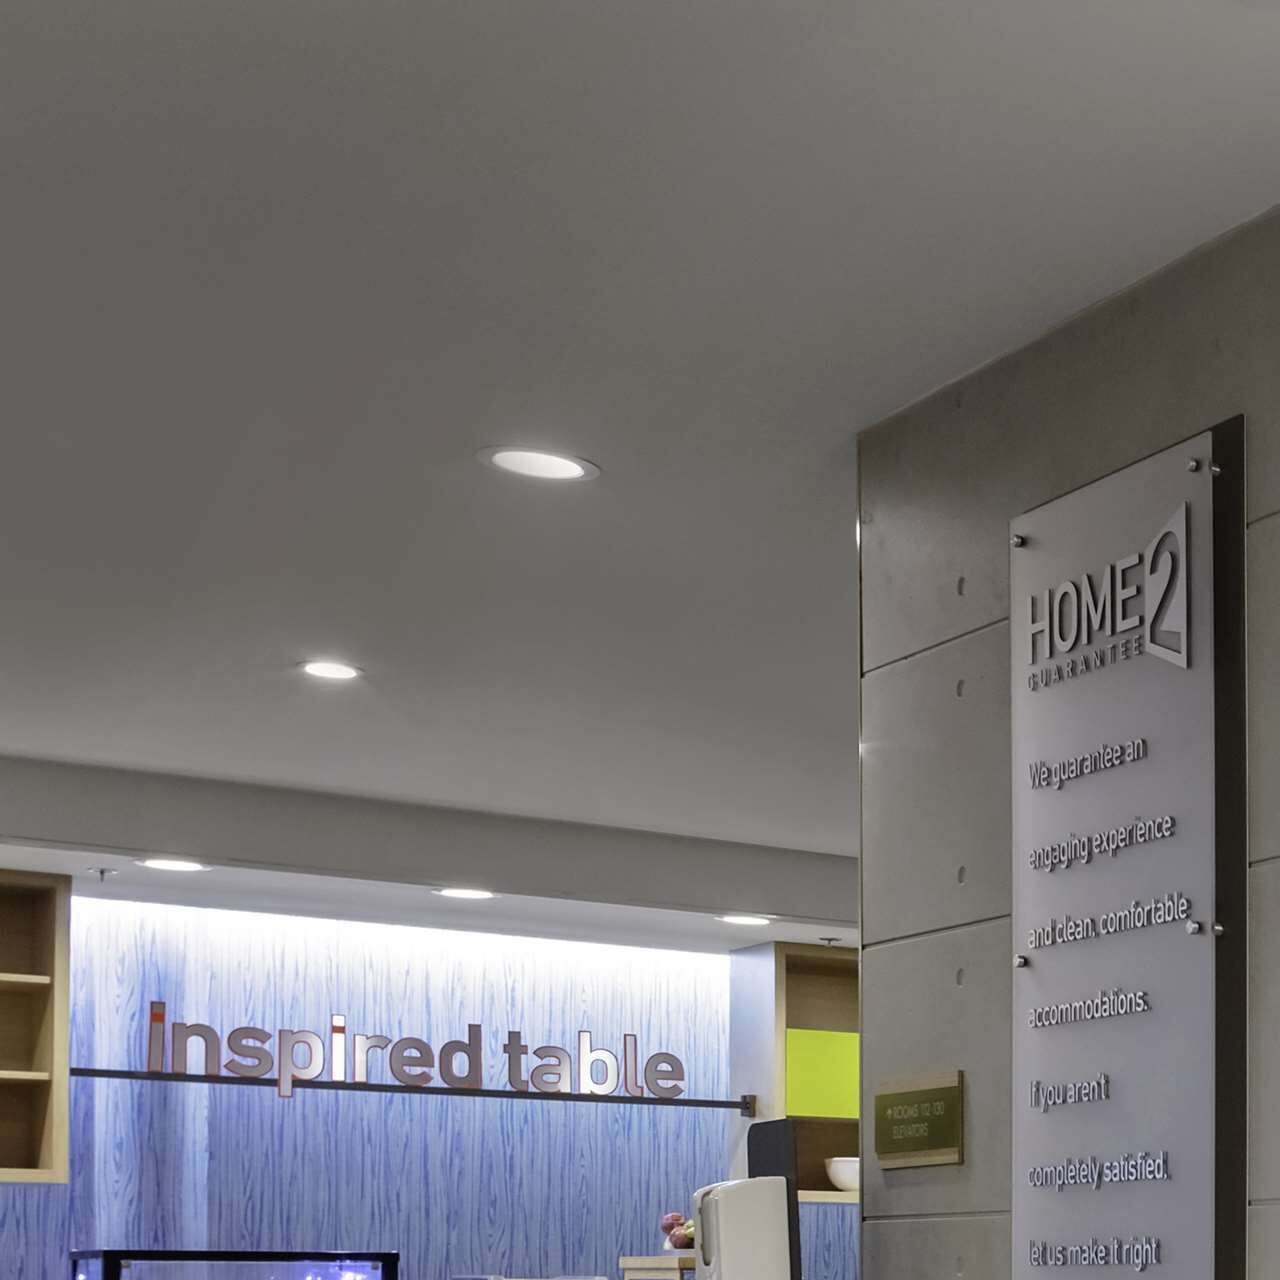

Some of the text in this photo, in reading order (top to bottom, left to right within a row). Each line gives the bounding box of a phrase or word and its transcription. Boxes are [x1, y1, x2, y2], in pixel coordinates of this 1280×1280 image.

[1027, 634, 1144, 691] GUARANTEE
[1028, 737, 1146, 790] We guarantee an
[1028, 815, 1174, 873] engaging experience
[1027, 917, 1052, 948] and
[1100, 892, 1190, 935] comfortable
[1027, 988, 1149, 1027] accommodations.
[148, 1001, 685, 1098] inspired table
[1030, 1073, 1109, 1113] If you aren't
[1027, 1154, 1101, 1191] completely
[1028, 1236, 1160, 1272] let us make it right
